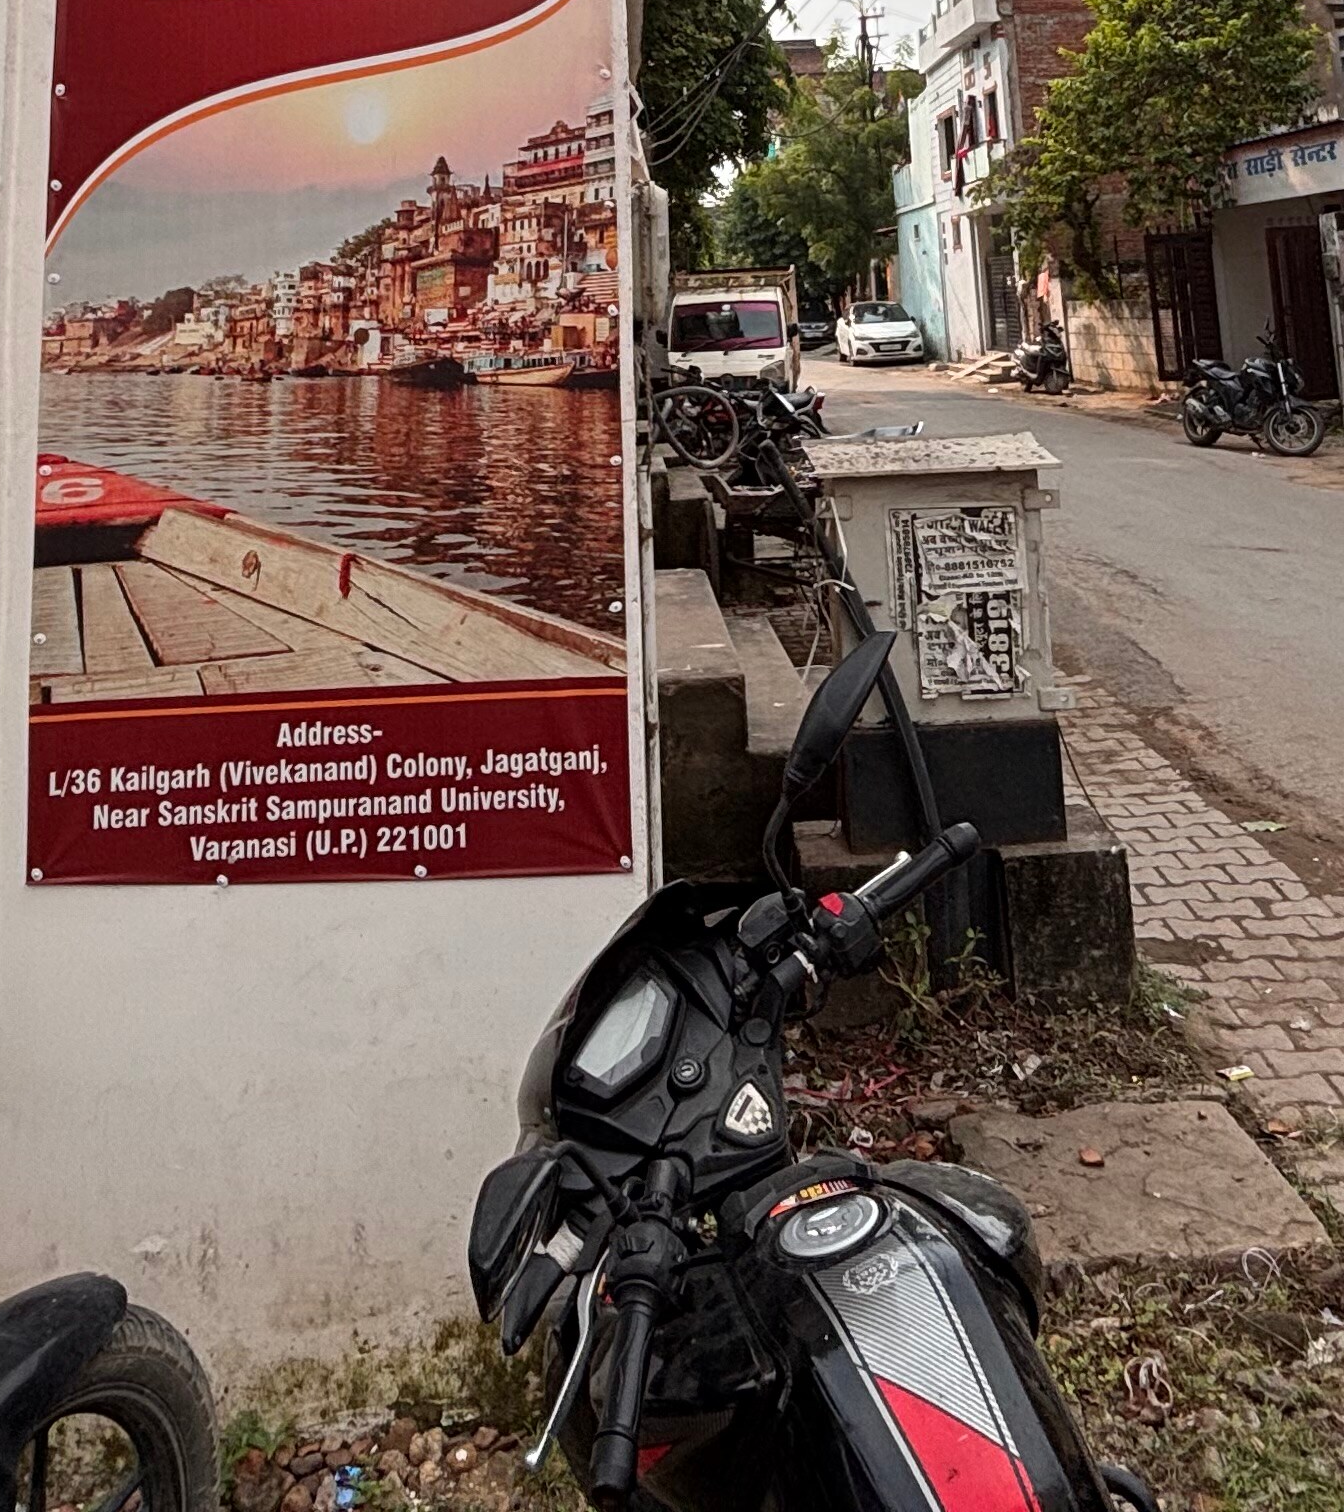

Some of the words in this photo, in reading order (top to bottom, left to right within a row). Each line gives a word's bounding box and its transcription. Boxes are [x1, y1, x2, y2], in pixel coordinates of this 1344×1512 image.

[1244, 147, 1284, 177] साड़ी
[277, 721, 383, 748] Address-
[49, 768, 101, 797] L/36
[110, 763, 210, 795] Kailgarh
[219, 755, 377, 792] (Vivekanand)
[386, 753, 474, 782] Colony,
[480, 744, 609, 776] Jagatganj,
[93, 801, 149, 830] Near
[158, 795, 258, 827] Sanskrit
[266, 787, 432, 824] Sampuranand
[441, 783, 565, 815] University,
[190, 831, 297, 862] Varanasi
[306, 828, 367, 860] (U.P.)
[376, 824, 467, 852] 221001
